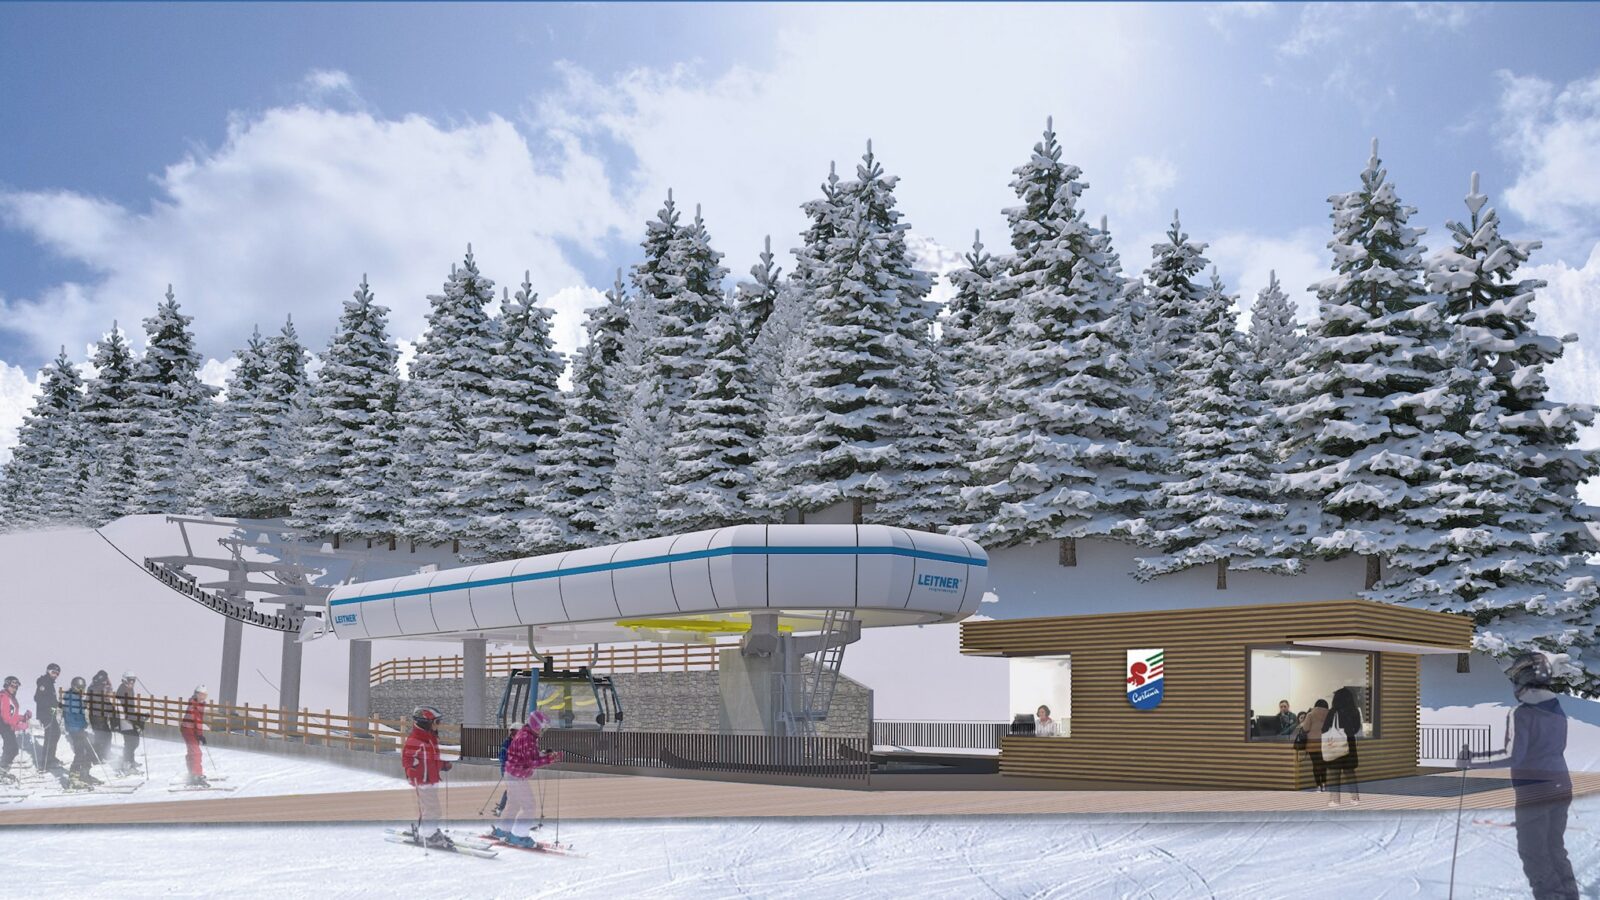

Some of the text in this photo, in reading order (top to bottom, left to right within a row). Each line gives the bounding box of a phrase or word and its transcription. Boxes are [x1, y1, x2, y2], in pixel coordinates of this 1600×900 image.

[918, 574, 960, 589] LEITNER
[335, 614, 357, 624] LEITNER
[1132, 687, 1160, 703] Cortina
